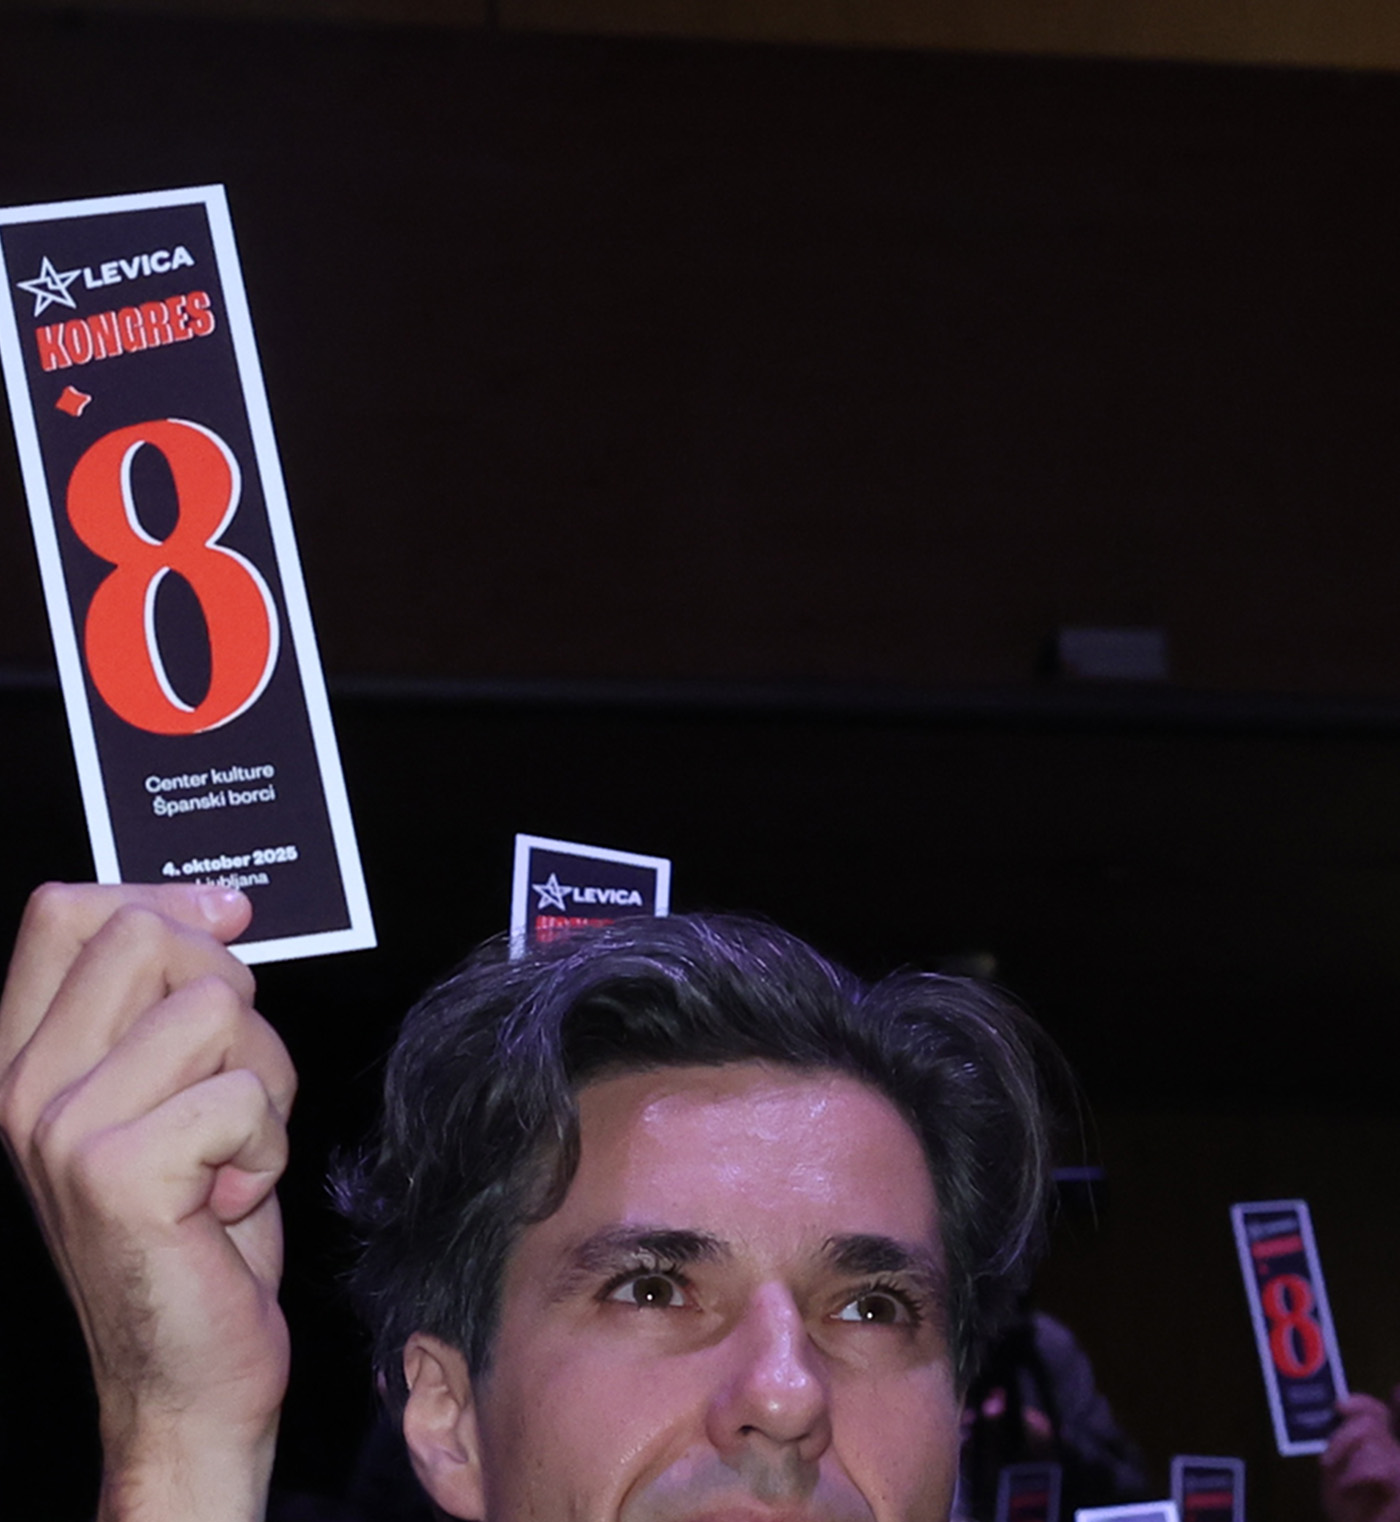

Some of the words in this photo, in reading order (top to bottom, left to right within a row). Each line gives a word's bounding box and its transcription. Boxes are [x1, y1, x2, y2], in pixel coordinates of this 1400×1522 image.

[84, 246, 195, 289] LEVICA
[35, 290, 215, 372] KONGRES
[66, 418, 281, 737] 8
[145, 772, 209, 793] Center
[210, 764, 276, 784] kulture
[153, 791, 226, 817] Španski
[227, 784, 277, 805] borci
[162, 861, 181, 876] 4.
[182, 854, 251, 875] oktober
[252, 845, 299, 866] 2025
[572, 887, 643, 906] LEVICA
[1261, 1274, 1326, 1379] 8
